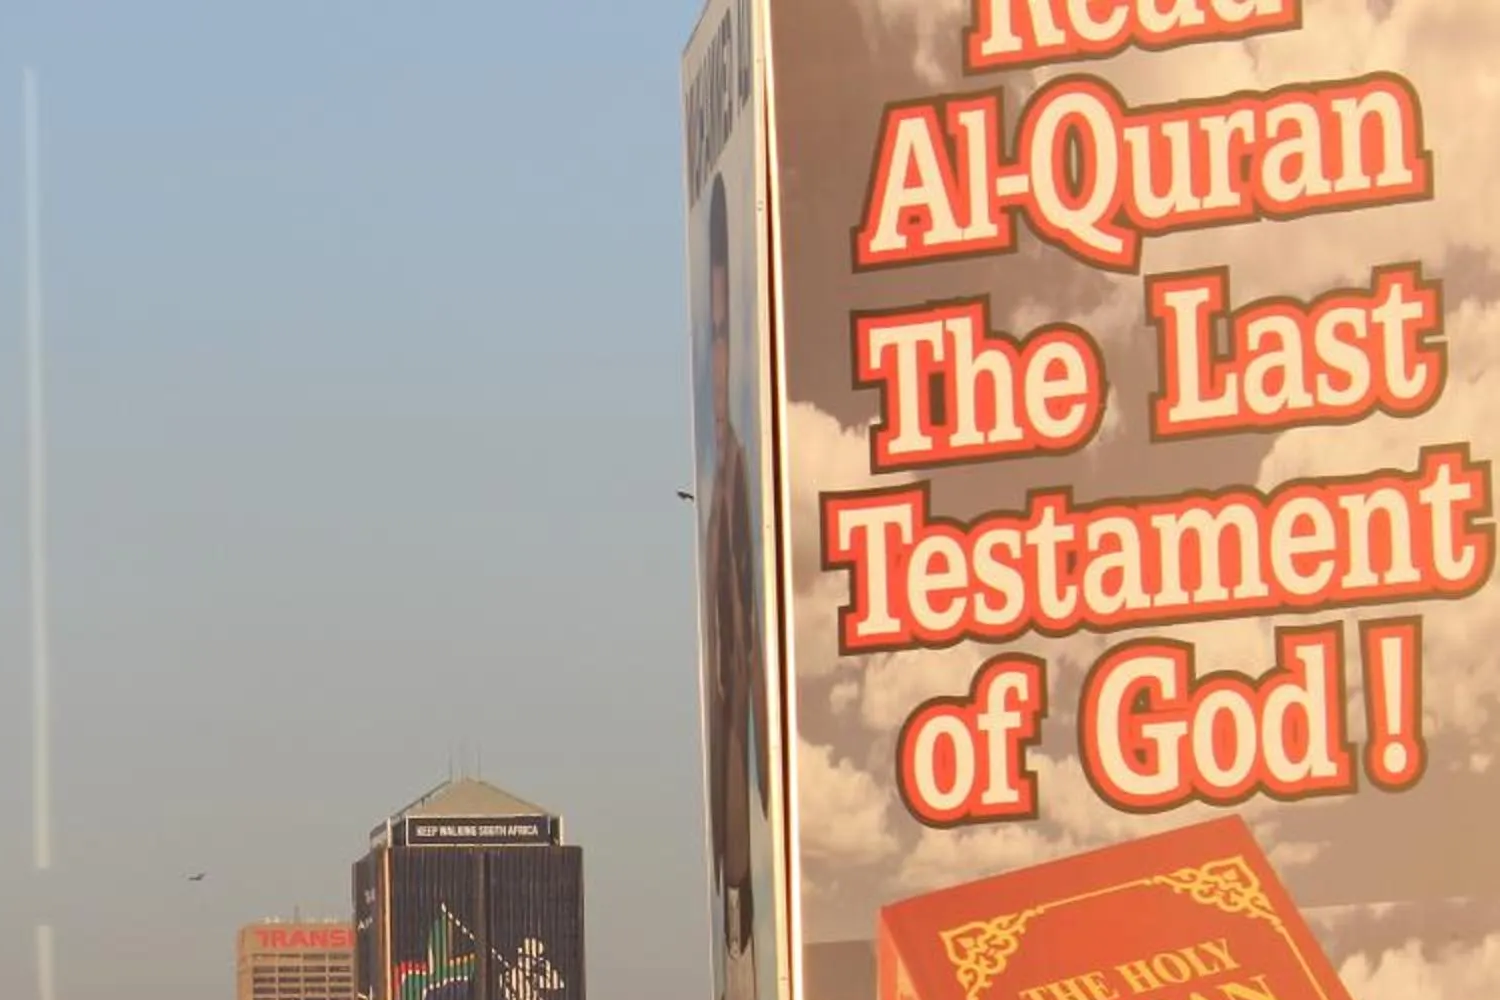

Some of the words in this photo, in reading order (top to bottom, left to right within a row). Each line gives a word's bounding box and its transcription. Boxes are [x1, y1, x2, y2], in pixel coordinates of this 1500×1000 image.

[864, 84, 1417, 258] Al-Quran
[864, 310, 1094, 460] The
[1160, 277, 1432, 428] Last
[833, 458, 1482, 641] Testament
[908, 662, 1034, 816] of
[1089, 634, 1412, 800] God!
[415, 825, 438, 837] KEEP
[439, 825, 477, 837] WALKING
[478, 825, 507, 837] SOUTH
[507, 824, 539, 836] AFRICA
[1114, 937, 1242, 994] HOLY
